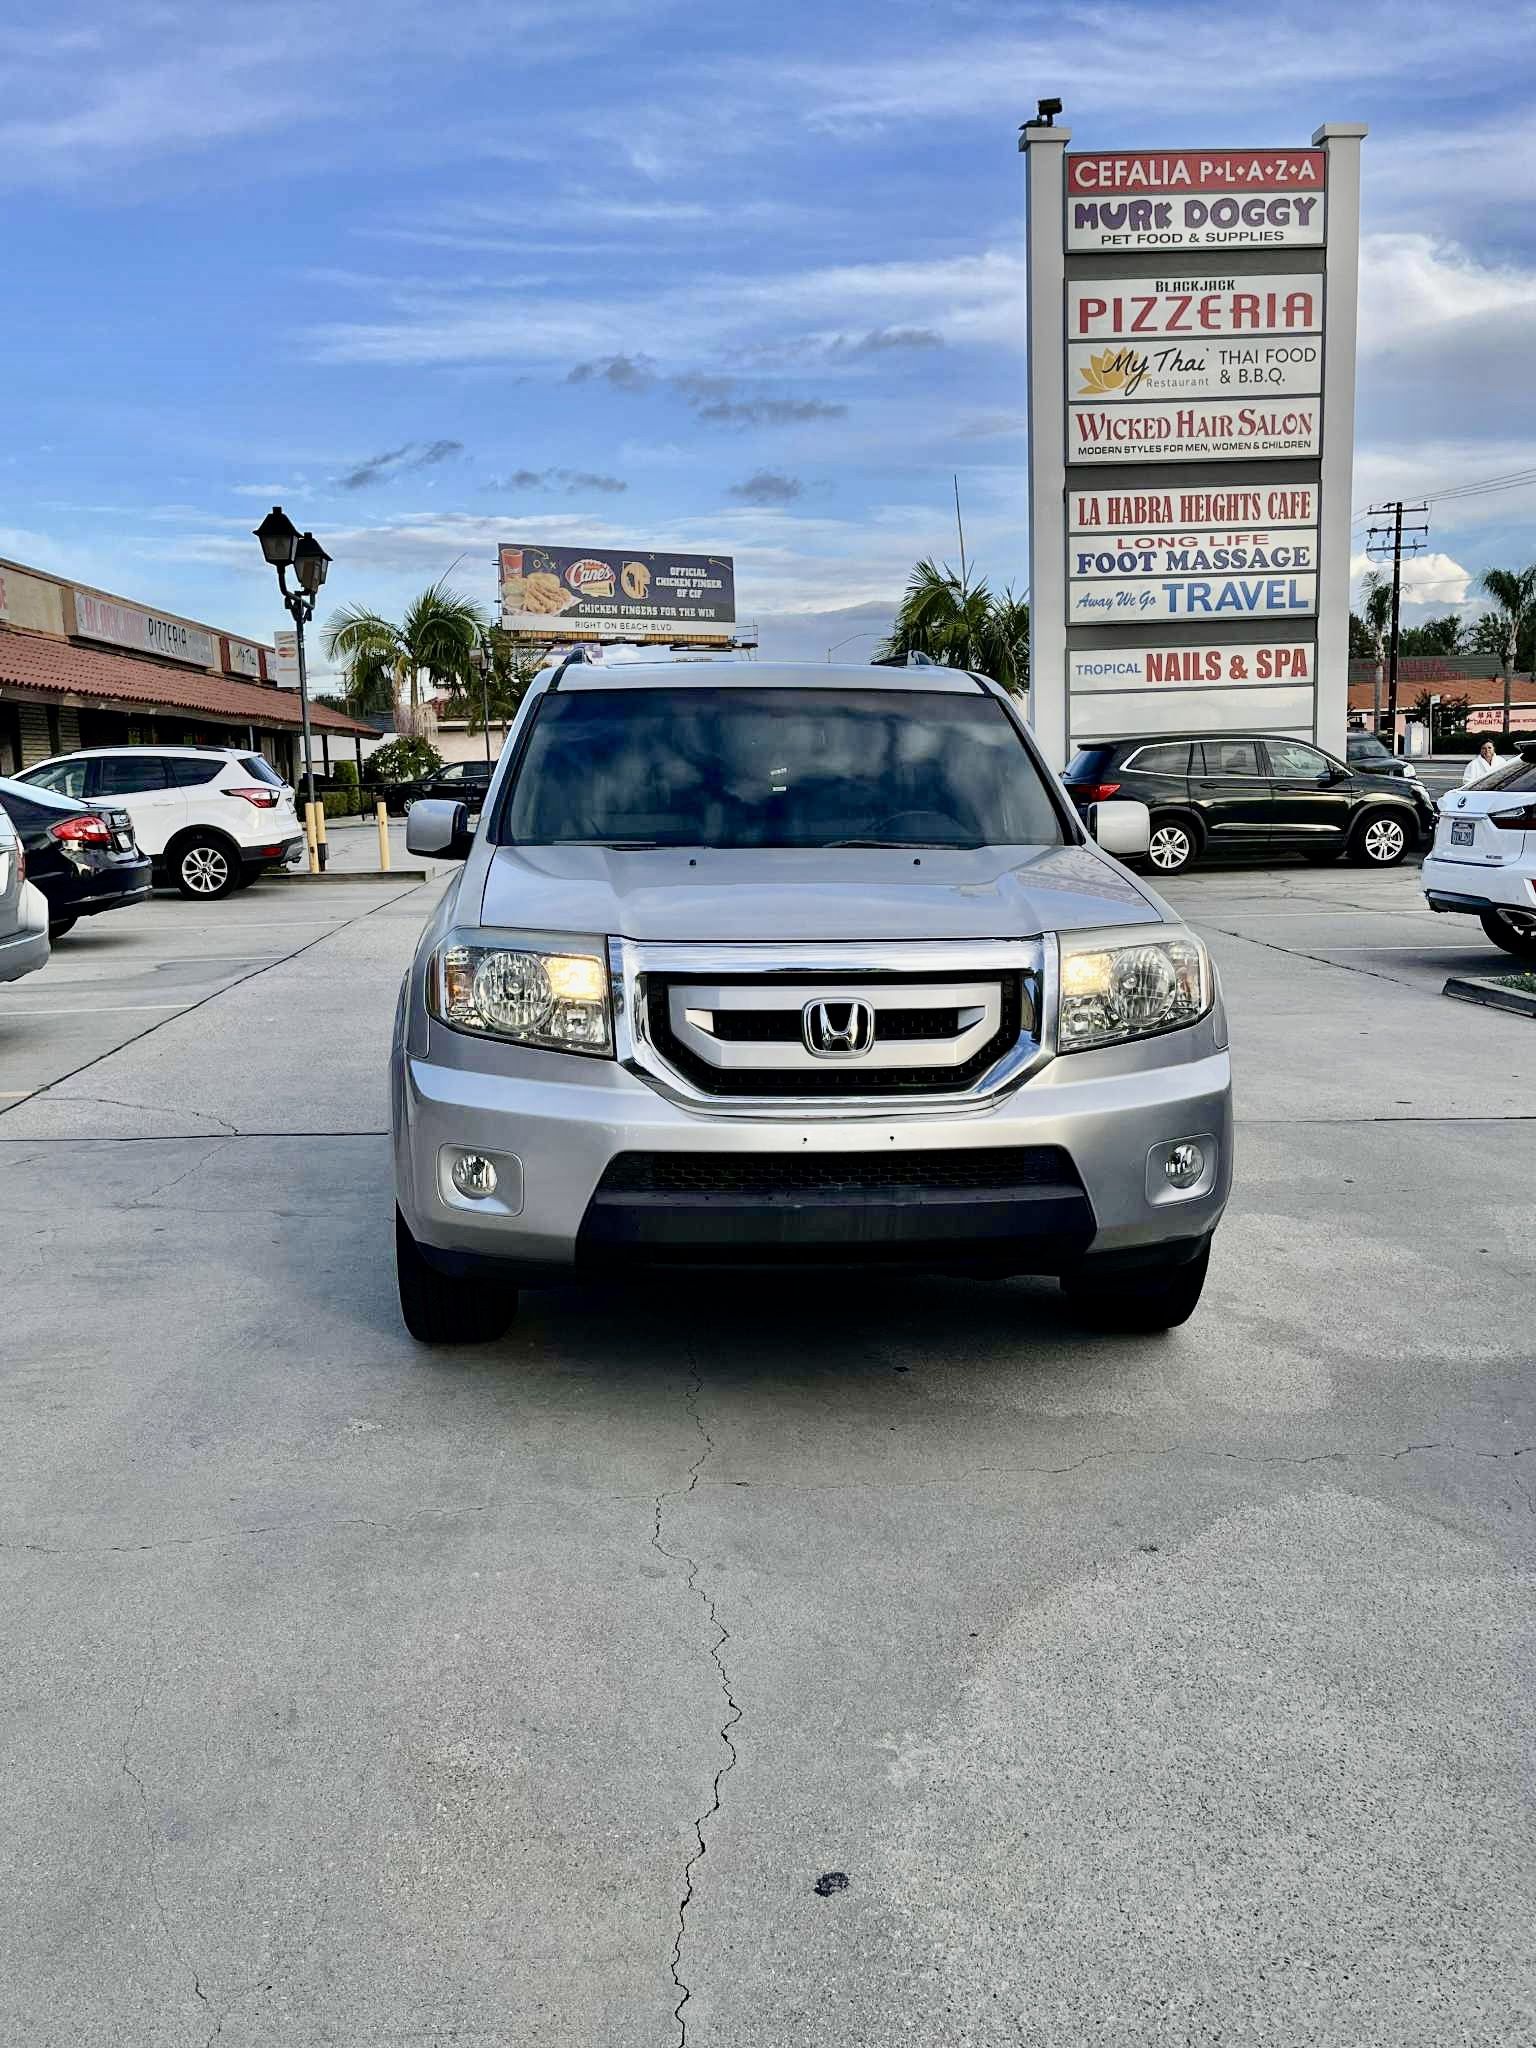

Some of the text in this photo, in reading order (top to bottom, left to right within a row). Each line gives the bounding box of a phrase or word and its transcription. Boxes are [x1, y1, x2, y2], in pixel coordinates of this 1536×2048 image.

[1074, 160, 1191, 187] CEFALIA
[1074, 197, 1318, 230] MURK DOGGY
[1102, 231, 1284, 244] PET FOOD & SUPPLIES
[1156, 280, 1235, 292] BLACKJACK
[1080, 292, 1312, 333] PIZZERIA
[1220, 348, 1316, 365] THAI FOOD
[1102, 347, 1211, 396] My Thai
[1220, 368, 1286, 384] & B.B.Q.
[1147, 378, 1210, 388] Restaurant
[1076, 408, 1312, 442] WICKED HAIR SALON
[1078, 446, 1122, 455] MODERN
[1124, 445, 1162, 454] STYLES
[1163, 444, 1184, 452] FOR
[1186, 444, 1210, 452] MEN,
[1212, 442, 1252, 450] WOMEN
[1262, 440, 1311, 450] CHILDREN
[1078, 491, 1310, 526] LA HABRA HEIGHTS CAFE
[1118, 534, 1270, 550] LONG LIFE
[1077, 546, 1310, 574] FOOT MASSAGE
[670, 567, 707, 577] OFFICIAL
[656, 577, 722, 588] CHICKEN FINGER
[677, 589, 688, 597] OF
[1076, 590, 1156, 609] Away We Go
[1162, 580, 1308, 613] TRAVEL
[579, 604, 715, 617] CHICKEN FINGERS FOR THE WIN
[575, 621, 600, 629] RIGHT
[620, 622, 648, 630] BEACH
[1076, 648, 1308, 682] TROPICAL NAILS & SPA
